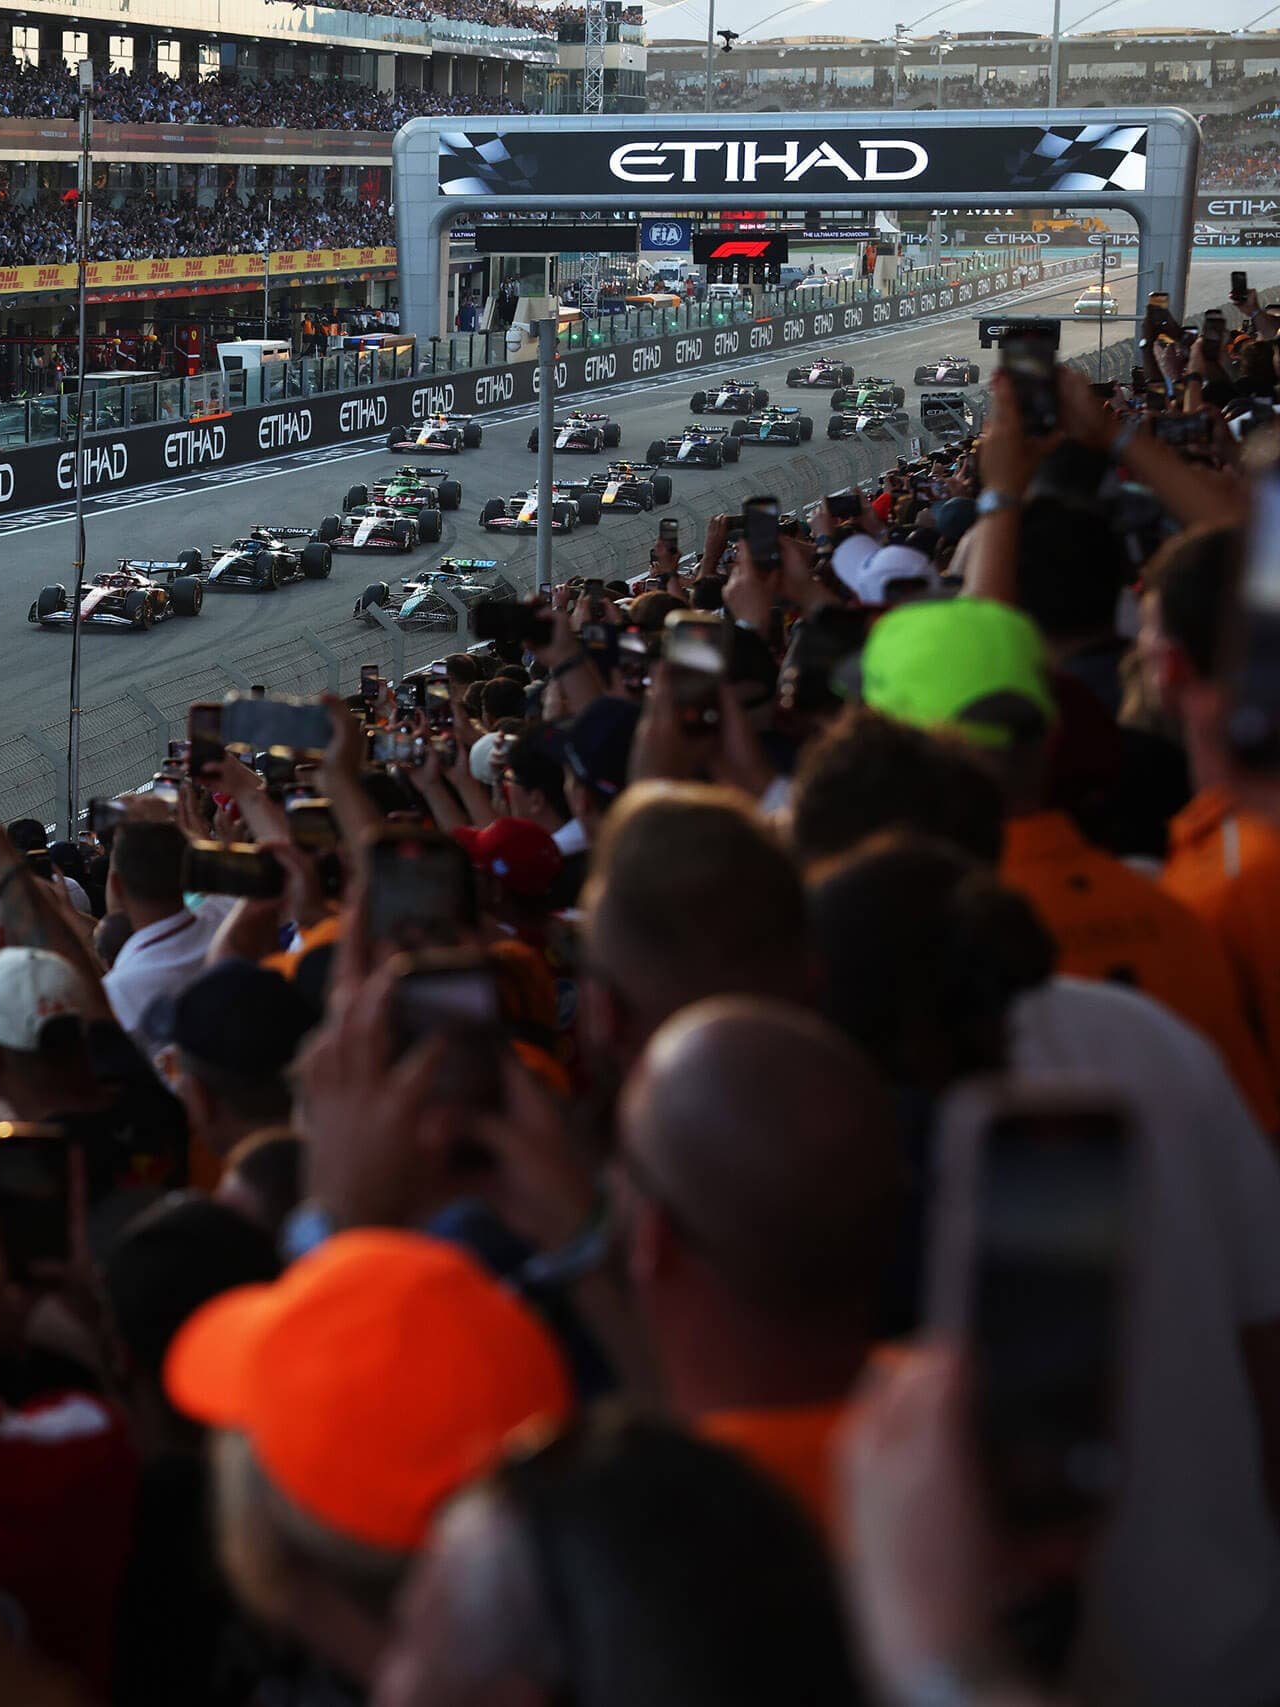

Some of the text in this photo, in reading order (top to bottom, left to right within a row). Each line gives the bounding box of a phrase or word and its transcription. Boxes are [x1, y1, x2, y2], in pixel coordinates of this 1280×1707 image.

[608, 140, 930, 183] ETIHAD
[1208, 200, 1277, 215] ETIHA
[985, 233, 1051, 245] ETIHAD
[675, 337, 703, 364] ETIHAD
[714, 331, 739, 356] ETIHAD
[749, 324, 774, 349] ETIHAD
[584, 352, 617, 383] ETIHAD
[632, 345, 661, 373] ETIHAD
[412, 383, 455, 418] ETIHAD
[475, 372, 514, 405] ETIHAD
[258, 408, 312, 450] ETIHAD
[339, 395, 387, 433] ETIHAD
[164, 425, 227, 469] ETIHAD
